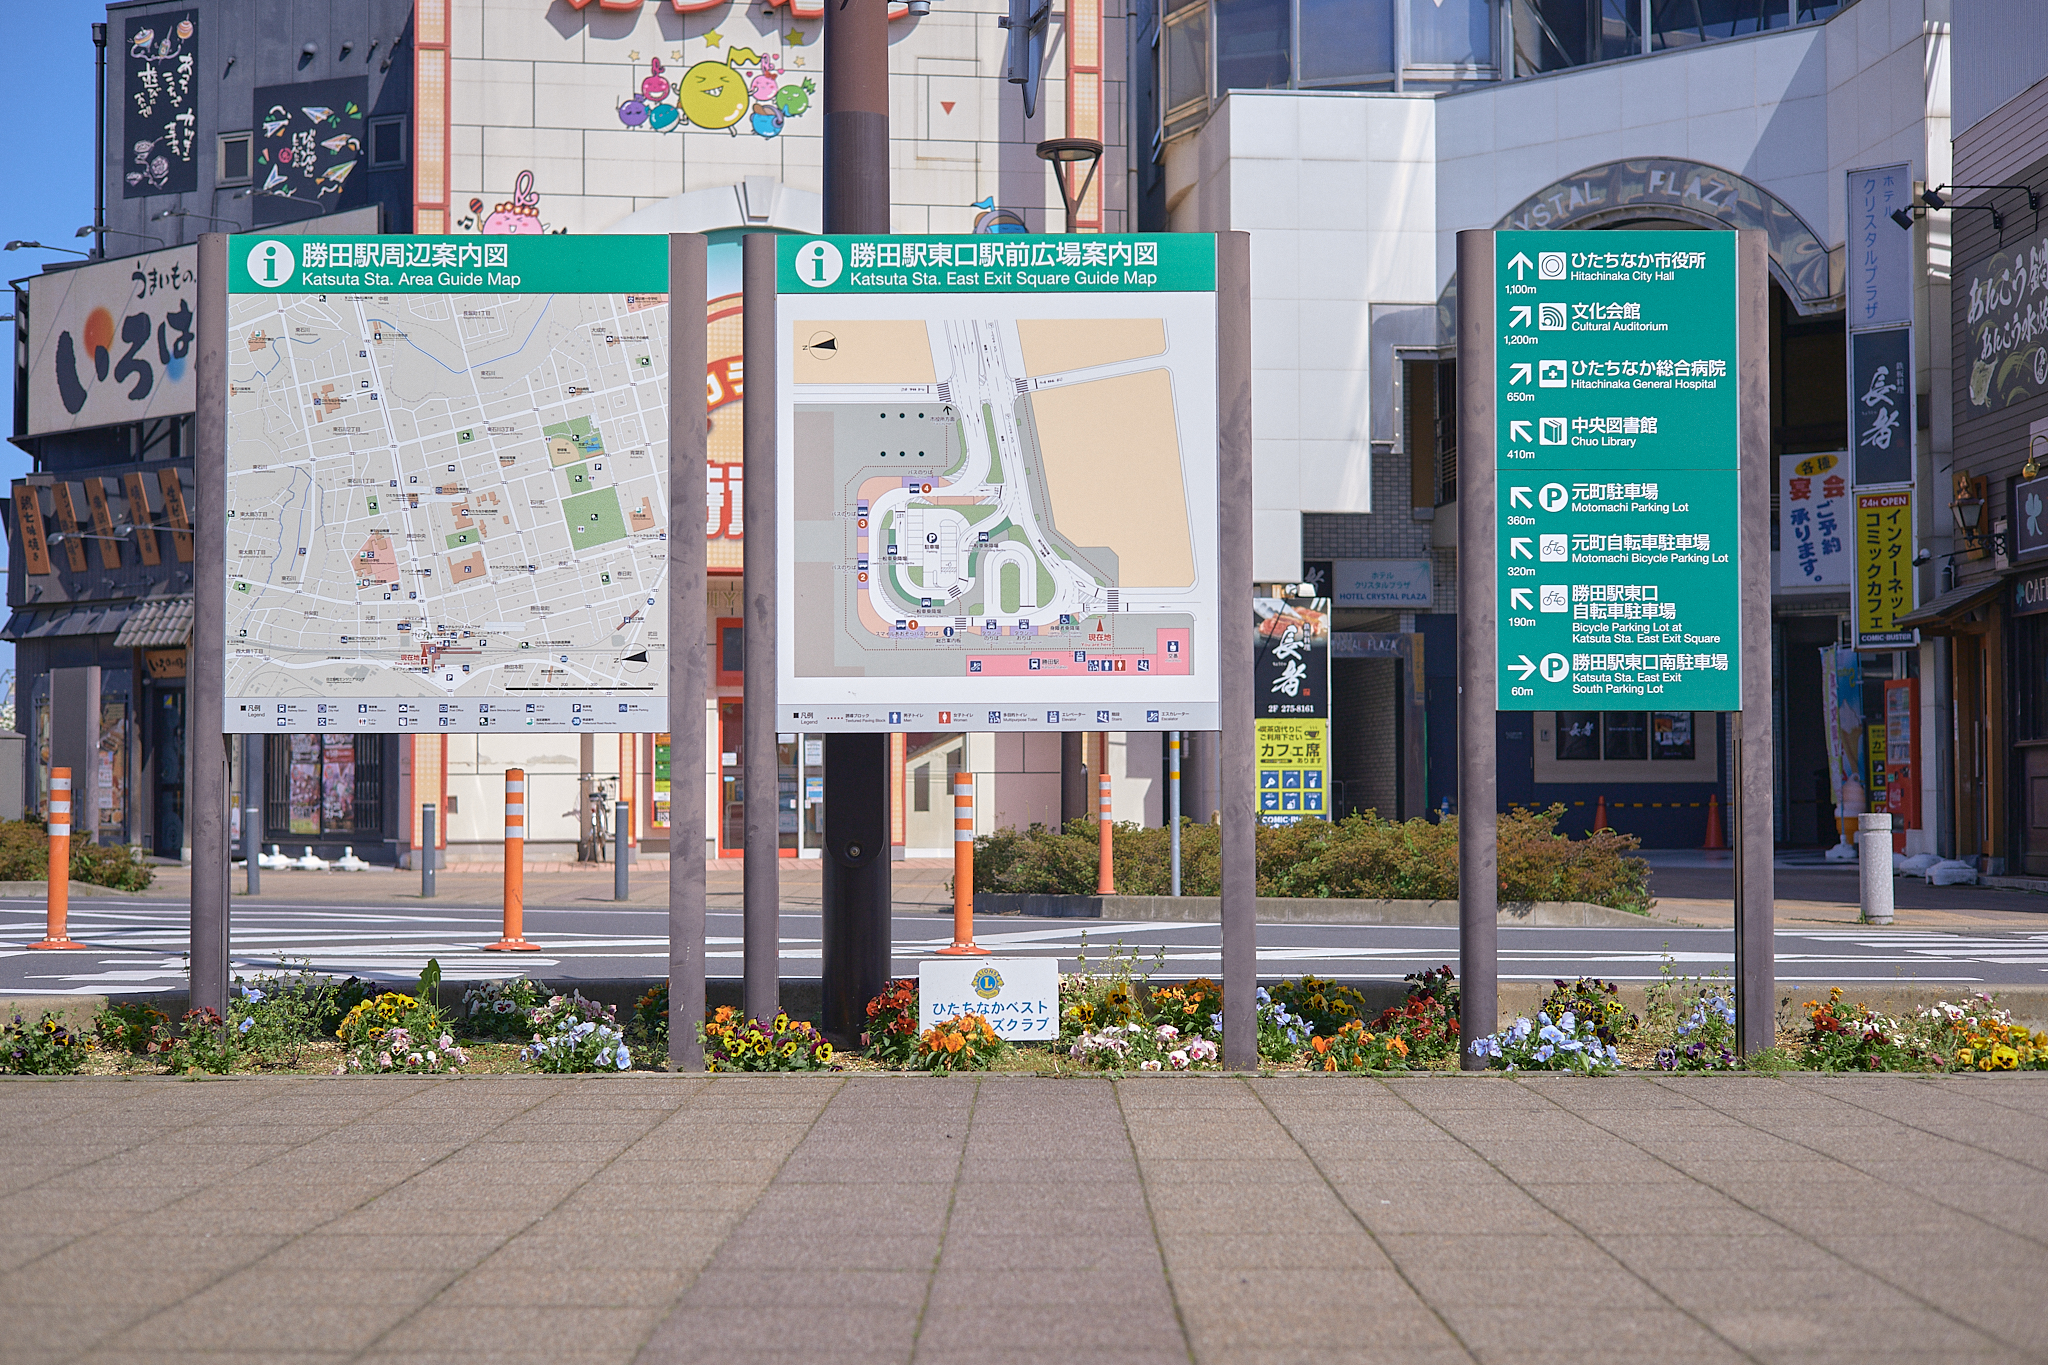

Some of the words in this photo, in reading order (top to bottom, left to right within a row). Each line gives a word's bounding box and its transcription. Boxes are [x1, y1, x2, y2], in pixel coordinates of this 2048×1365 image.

[1648, 169, 1739, 215] PLAZA
[1864, 178, 1878, 319] クリスタルプラザ
[302, 243, 507, 267] 勝田駅周辺案内図
[850, 241, 1157, 268] 勝田駅東口駅前広場案内図
[1572, 252, 1706, 269] ひたちなか市役所
[303, 273, 360, 285] Katsuta
[365, 272, 393, 285] Sta.
[399, 273, 433, 285] Area
[438, 272, 482, 285] Guide
[488, 273, 520, 288] Map
[851, 273, 907, 285] Katsuta
[912, 272, 941, 285] Sta.
[947, 272, 979, 285] East
[985, 272, 1011, 285] Exit
[1017, 271, 1070, 287] Square
[1075, 271, 1119, 284] Guide
[1124, 271, 1157, 287] Map
[1571, 271, 1629, 280] Hitachinaka
[1632, 271, 1652, 282] City
[1655, 271, 1674, 280] Hall
[1505, 285, 1536, 295] 1,100m
[1572, 302, 1640, 319] 文化会館
[1572, 322, 1610, 331] Cultural
[1613, 322, 1668, 331] Auditorium
[1504, 335, 1538, 345] 1,200m
[1572, 360, 1726, 377] ひたちなか総合病院
[1571, 379, 1630, 388] Hitachinaka
[1633, 379, 1672, 388] General
[1675, 379, 1716, 390] Hospital
[1507, 392, 1534, 401] 650m
[1572, 417, 1657, 434] 中央図書館
[1571, 437, 1598, 446] Chuo
[1602, 437, 1636, 448] Library
[1507, 450, 1535, 459] 410m
[1801, 455, 1832, 475] 各種
[1572, 483, 1658, 500] 元町駐車場
[1789, 475, 1845, 501] 宴会
[1880, 496, 1907, 507] OPEN
[1572, 503, 1628, 512] Motomachi
[1631, 503, 1669, 514] Parking
[1672, 503, 1688, 511] Lot
[1507, 516, 1535, 525] 360m
[1816, 501, 1842, 555] ご予約
[1572, 534, 1710, 551] 元町自転車駐車場
[1572, 554, 1628, 562] Motomachi
[1632, 553, 1668, 564] Bicycle
[1671, 553, 1709, 564] Parking
[1712, 554, 1728, 562] Lot
[1372, 572, 1394, 580] ホテル
[1508, 567, 1535, 576] 320m
[1866, 512, 1884, 629] コミックカフェ
[1355, 581, 1411, 590] クリスタルプラザ
[1572, 585, 1657, 604] 勝田駅東口
[1574, 603, 1676, 620] 自転車駐車場
[1509, 618, 1535, 626] 190m
[1573, 623, 1609, 634] Bicycle
[1612, 623, 1650, 634] Parking
[1653, 623, 1669, 631] Lot
[1672, 623, 1682, 631] at
[1088, 633, 1112, 642] 現在地
[1573, 634, 1611, 643] Katsuta
[1614, 634, 1634, 643] Sta.
[1637, 634, 1659, 643] East
[1662, 634, 1681, 643] Exit
[1684, 634, 1720, 645] Square
[1573, 653, 1728, 671] 勝田駅東口南駐車場
[1573, 673, 1611, 682] Katsuta
[1614, 673, 1634, 682] Sta.
[1638, 673, 1659, 682] East
[1663, 673, 1681, 682] Exit
[1512, 687, 1533, 696] 60m
[1573, 684, 1602, 693] South
[1606, 684, 1644, 695] Parking
[1647, 684, 1663, 693] Lot
[1281, 704, 1314, 713] 275-8161
[1262, 744, 1320, 757] カフェ席
[933, 1001, 1048, 1015] ひたちなかベスト
